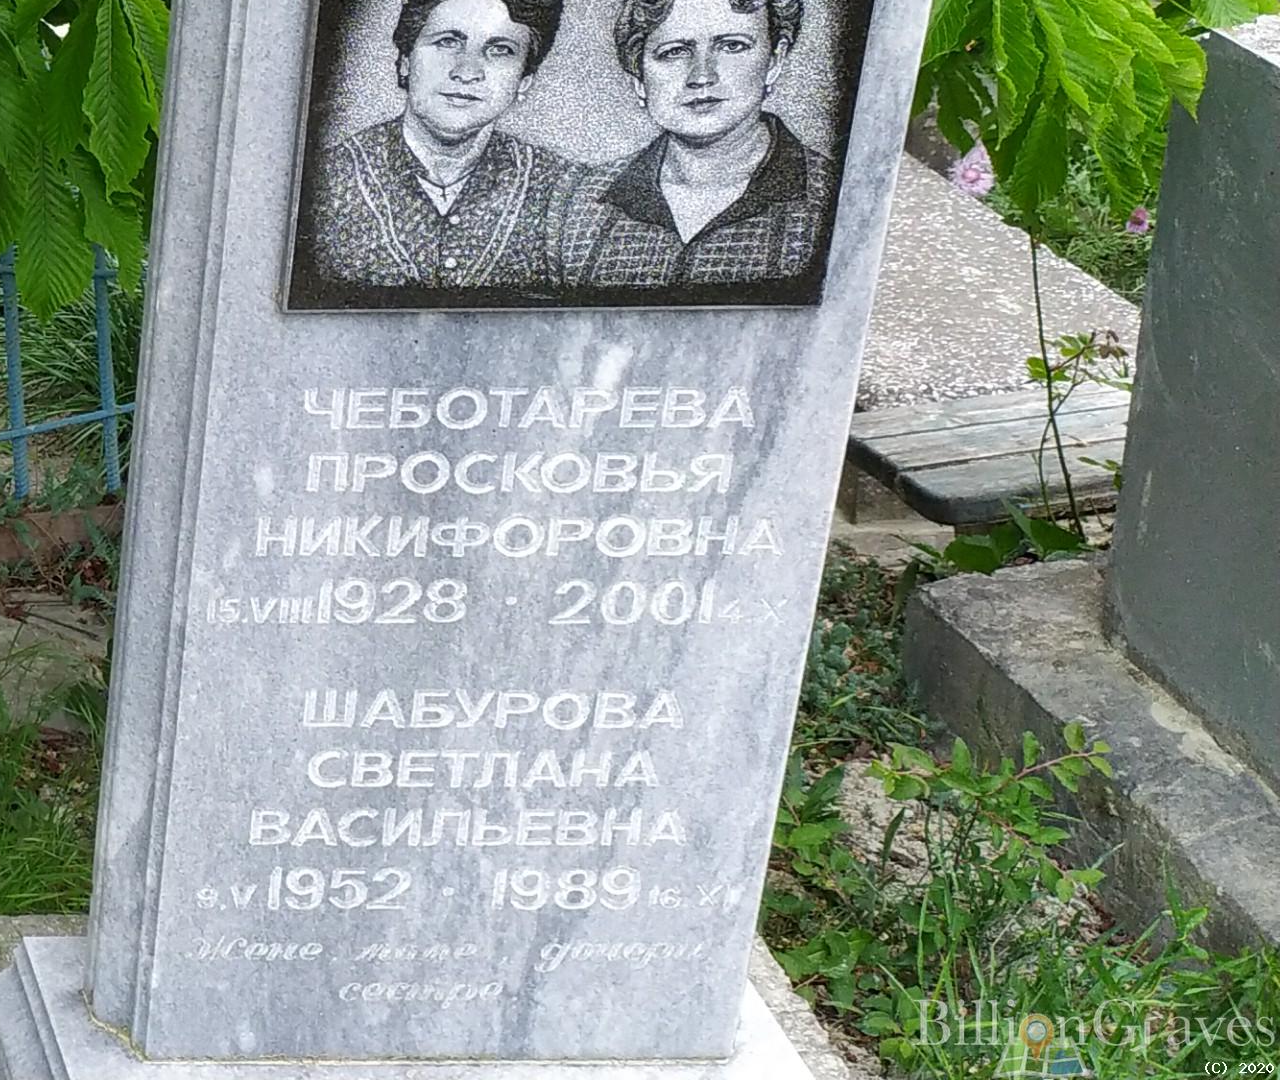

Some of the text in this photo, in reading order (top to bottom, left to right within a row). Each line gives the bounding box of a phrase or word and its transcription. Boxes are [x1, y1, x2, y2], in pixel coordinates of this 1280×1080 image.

[304, 385, 756, 431] ЧЕБОТАРЕВА
[305, 451, 734, 495] ПРОСКОВЬЯ
[255, 514, 785, 558] НИКИФОРОВНА
[317, 577, 468, 624] 1928
[548, 578, 716, 624] 2001
[302, 688, 685, 729] ШАБУРОВА
[307, 749, 659, 790] СВЕТЛАНА
[248, 807, 687, 848] ВАСИЛЬЕВНА
[268, 866, 412, 911] 1952
[491, 864, 641, 911] 1989
